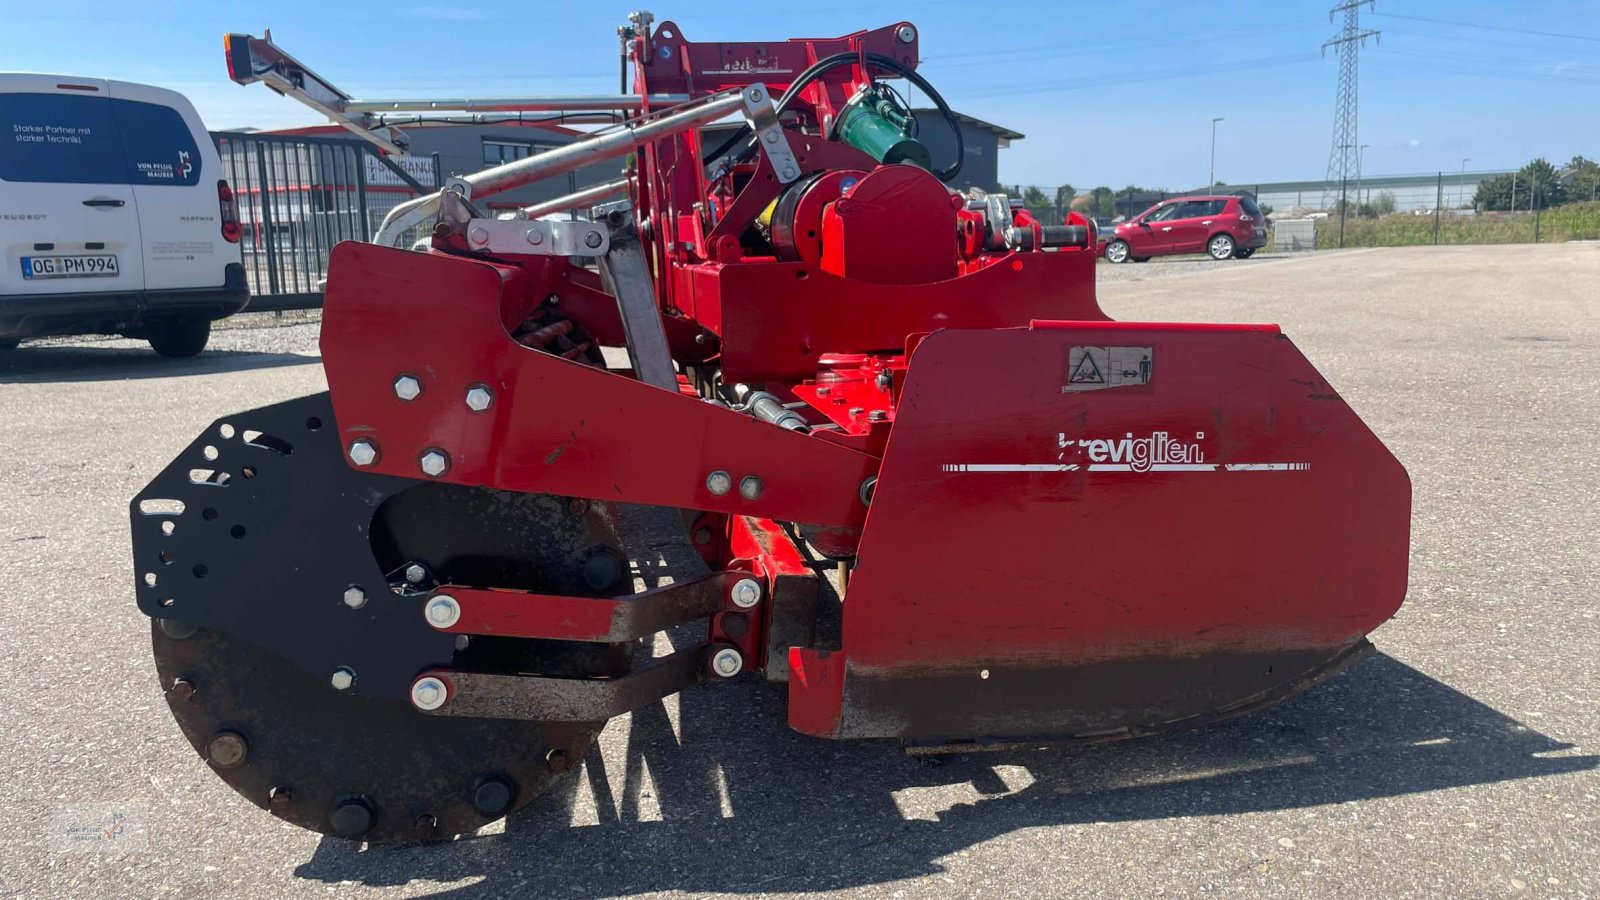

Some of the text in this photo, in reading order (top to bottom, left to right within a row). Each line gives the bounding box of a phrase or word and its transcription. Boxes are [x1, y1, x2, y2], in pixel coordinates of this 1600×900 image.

[13, 124, 91, 135] Starker Partner mit
[15, 134, 45, 143] starker
[33, 259, 54, 273] OG
[64, 258, 85, 272] PM
[87, 257, 115, 271] 994
